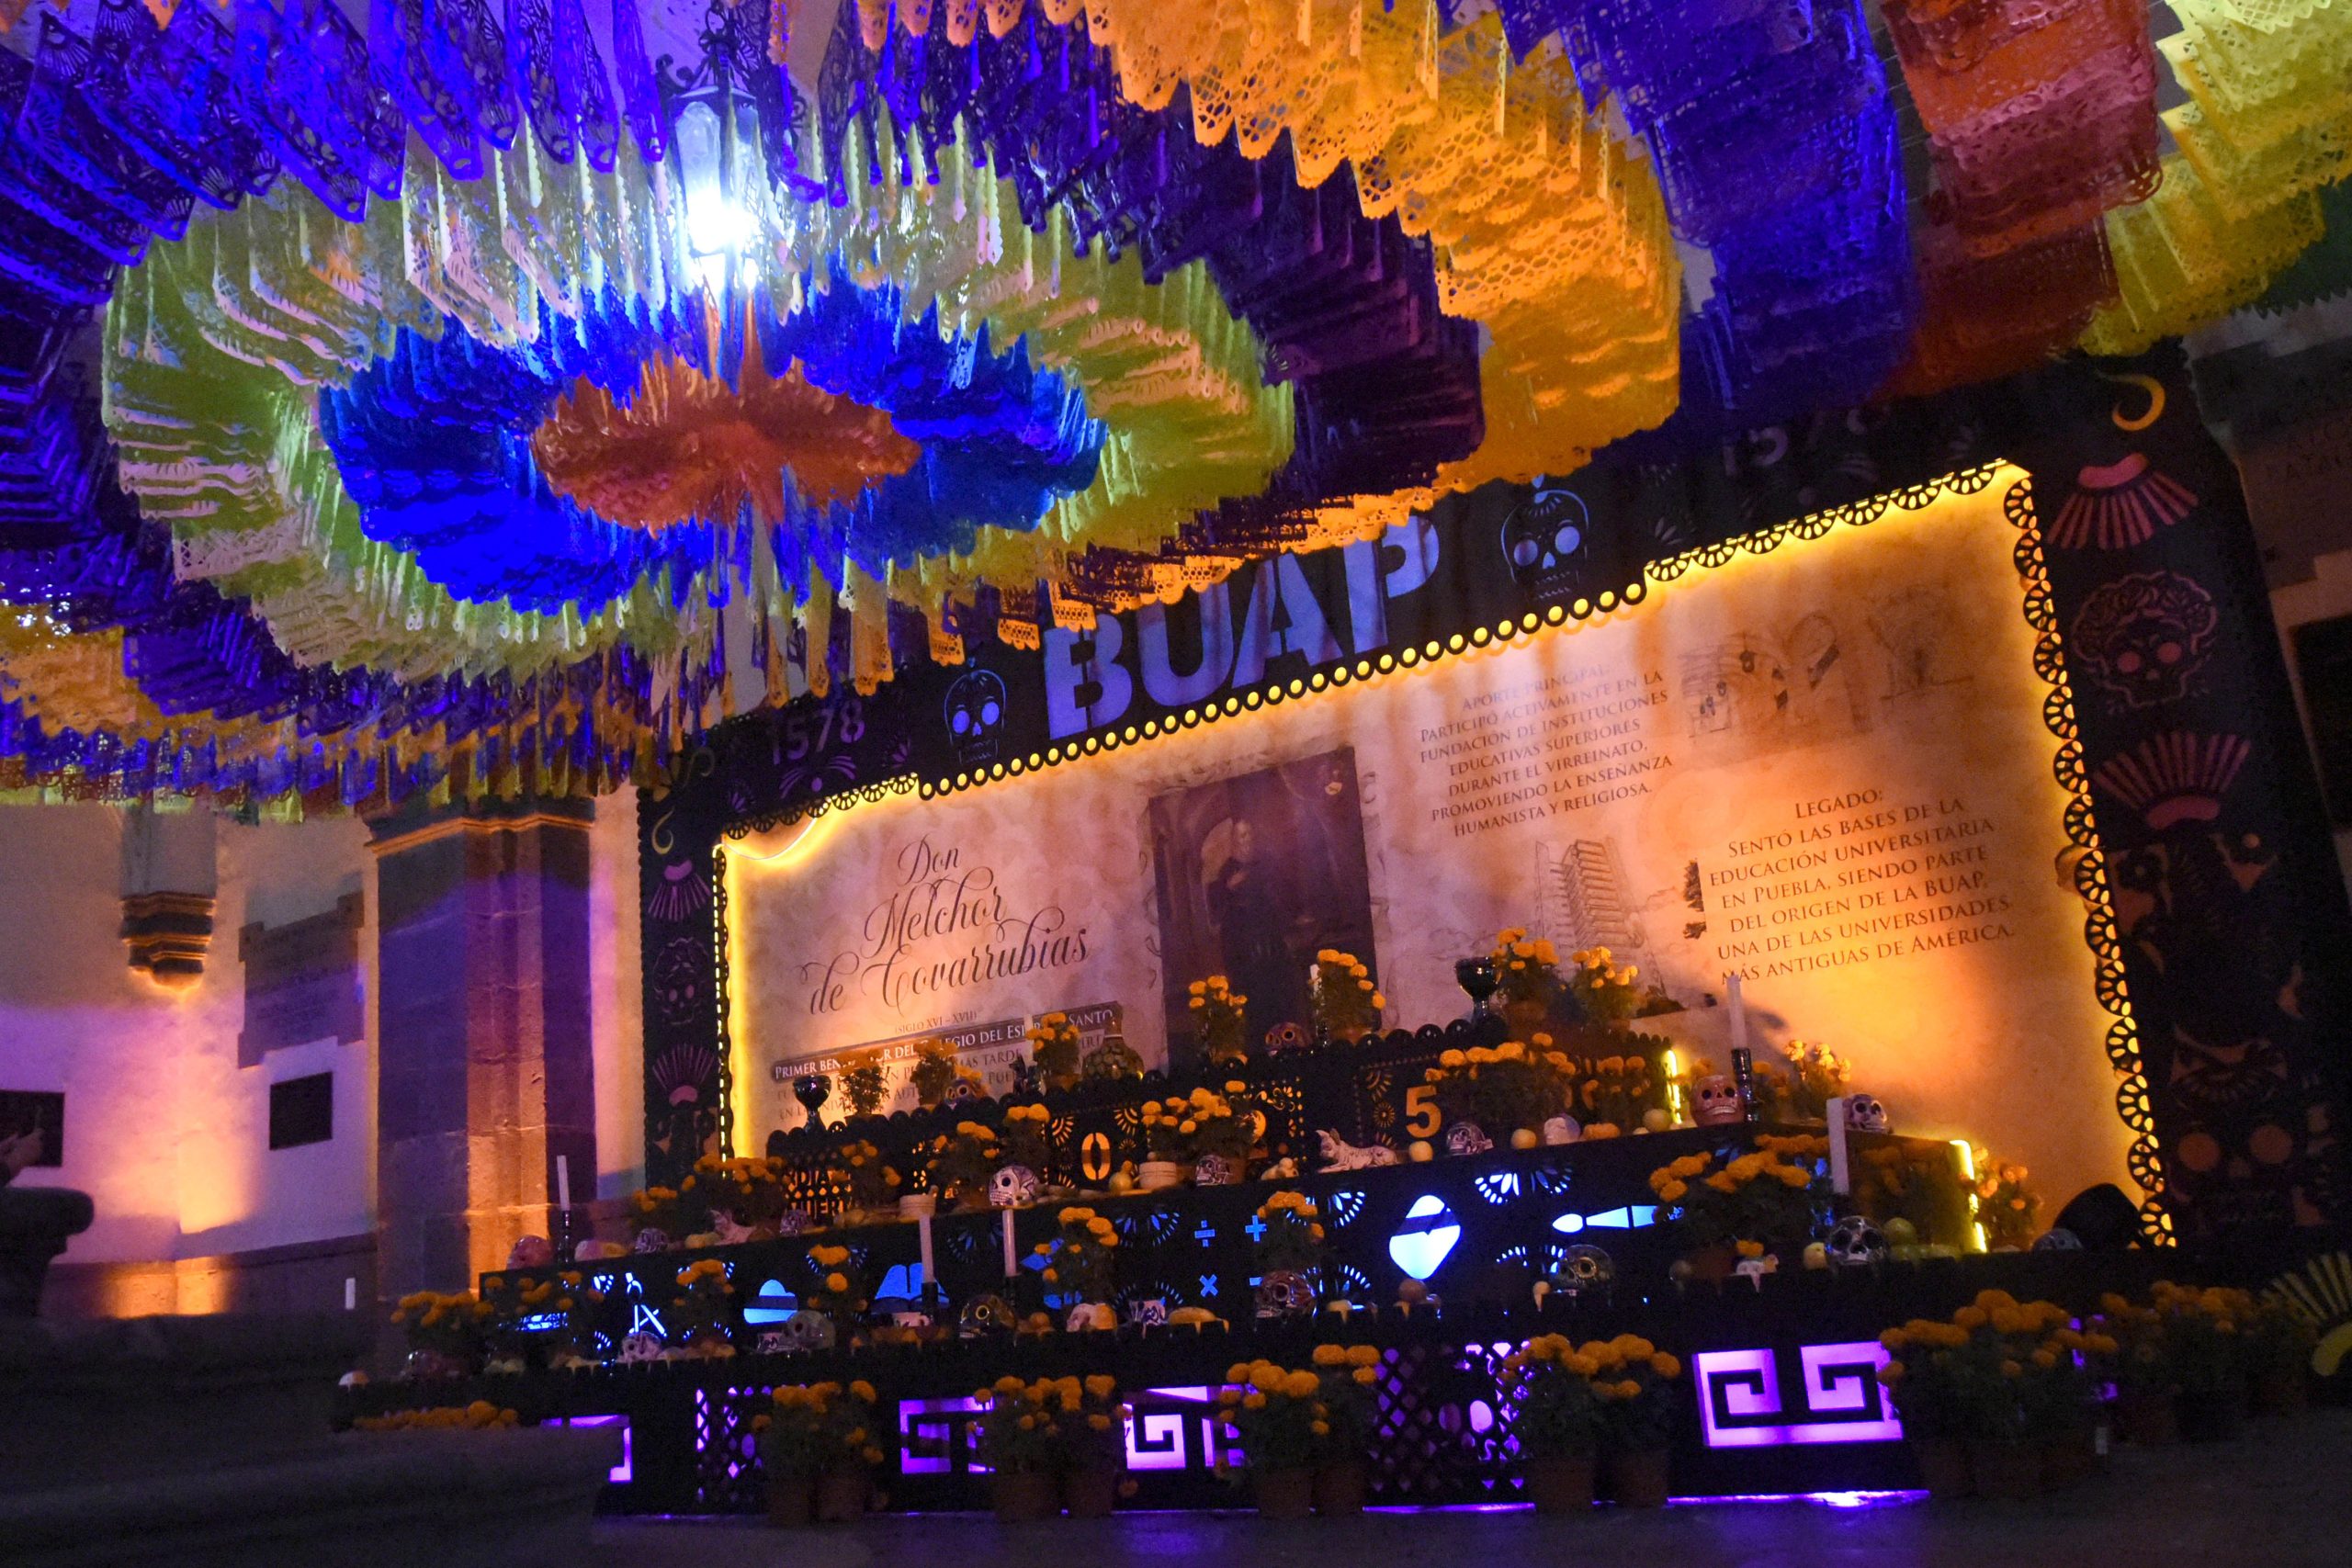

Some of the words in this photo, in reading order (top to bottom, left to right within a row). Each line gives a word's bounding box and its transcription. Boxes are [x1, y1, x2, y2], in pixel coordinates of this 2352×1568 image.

[1043, 514, 1440, 740] BUAP
[1420, 710, 1498, 742] PARTICIPÓ
[1503, 683, 1611, 720] ACTIVAMENTE
[1617, 677, 1636, 692] EN
[1644, 671, 1663, 685] LA
[1420, 730, 1510, 763] FUNDACIÓN
[1517, 725, 1536, 738] DE
[1543, 690, 1668, 732] INSTITUCIONES
[1463, 688, 1520, 710] APORTE
[1449, 769, 1521, 796] DURANTE
[1526, 764, 1542, 778] EL
[1545, 739, 1647, 773] VIRREINATO,
[1450, 746, 1541, 776] EDUCATIVAS
[1545, 718, 1640, 751] SUPERIORES
[1431, 784, 1548, 821] PROMOVIENDO
[1554, 778, 1571, 793] LA
[1577, 755, 1673, 787] ENSEÑANZA
[1453, 807, 1545, 837] HUMANISTA
[1549, 801, 1559, 814] Y
[1564, 783, 1652, 811] RELIGIOSA.
[1795, 789, 1883, 818] LEGADO:
[1709, 850, 1827, 886] EDUCACIÓN
[1835, 818, 1995, 862] UNIVERSITARIA
[1728, 829, 1792, 858] SENTÓ
[1800, 824, 1832, 843] LAS
[1839, 809, 1897, 835] BASES
[1904, 804, 1930, 822] DE
[1939, 798, 1964, 815] LA
[898, 833, 961, 886] Don
[1722, 892, 1746, 909] EN
[1754, 878, 1831, 903] PUEBLA,
[1838, 859, 1917, 887] SIENDO
[1925, 846, 1988, 871] PARTE
[860, 866, 1006, 960] Melchor
[1718, 941, 1759, 960] UNA
[1767, 934, 1792, 952] DE
[1799, 927, 1832, 946] LAS
[1839, 896, 2010, 939] UNIVERSIDADES
[1730, 914, 1767, 933] DEL
[1771, 897, 1850, 924] ORIGEN
[1860, 891, 1885, 909] DE
[1894, 886, 1918, 903] LA
[794, 952, 860, 1015] de
[861, 906, 1089, 1016] Covarrubias
[1767, 946, 1869, 977] ANTIGUAS
[1877, 941, 1904, 958] DE
[775, 1060, 817, 1079] PRIMER
[895, 1043, 917, 1058] DEL
[979, 1029, 1003, 1044] DEL
[1406, 1085, 1442, 1138] 5
[1081, 1132, 1111, 1180] 0
